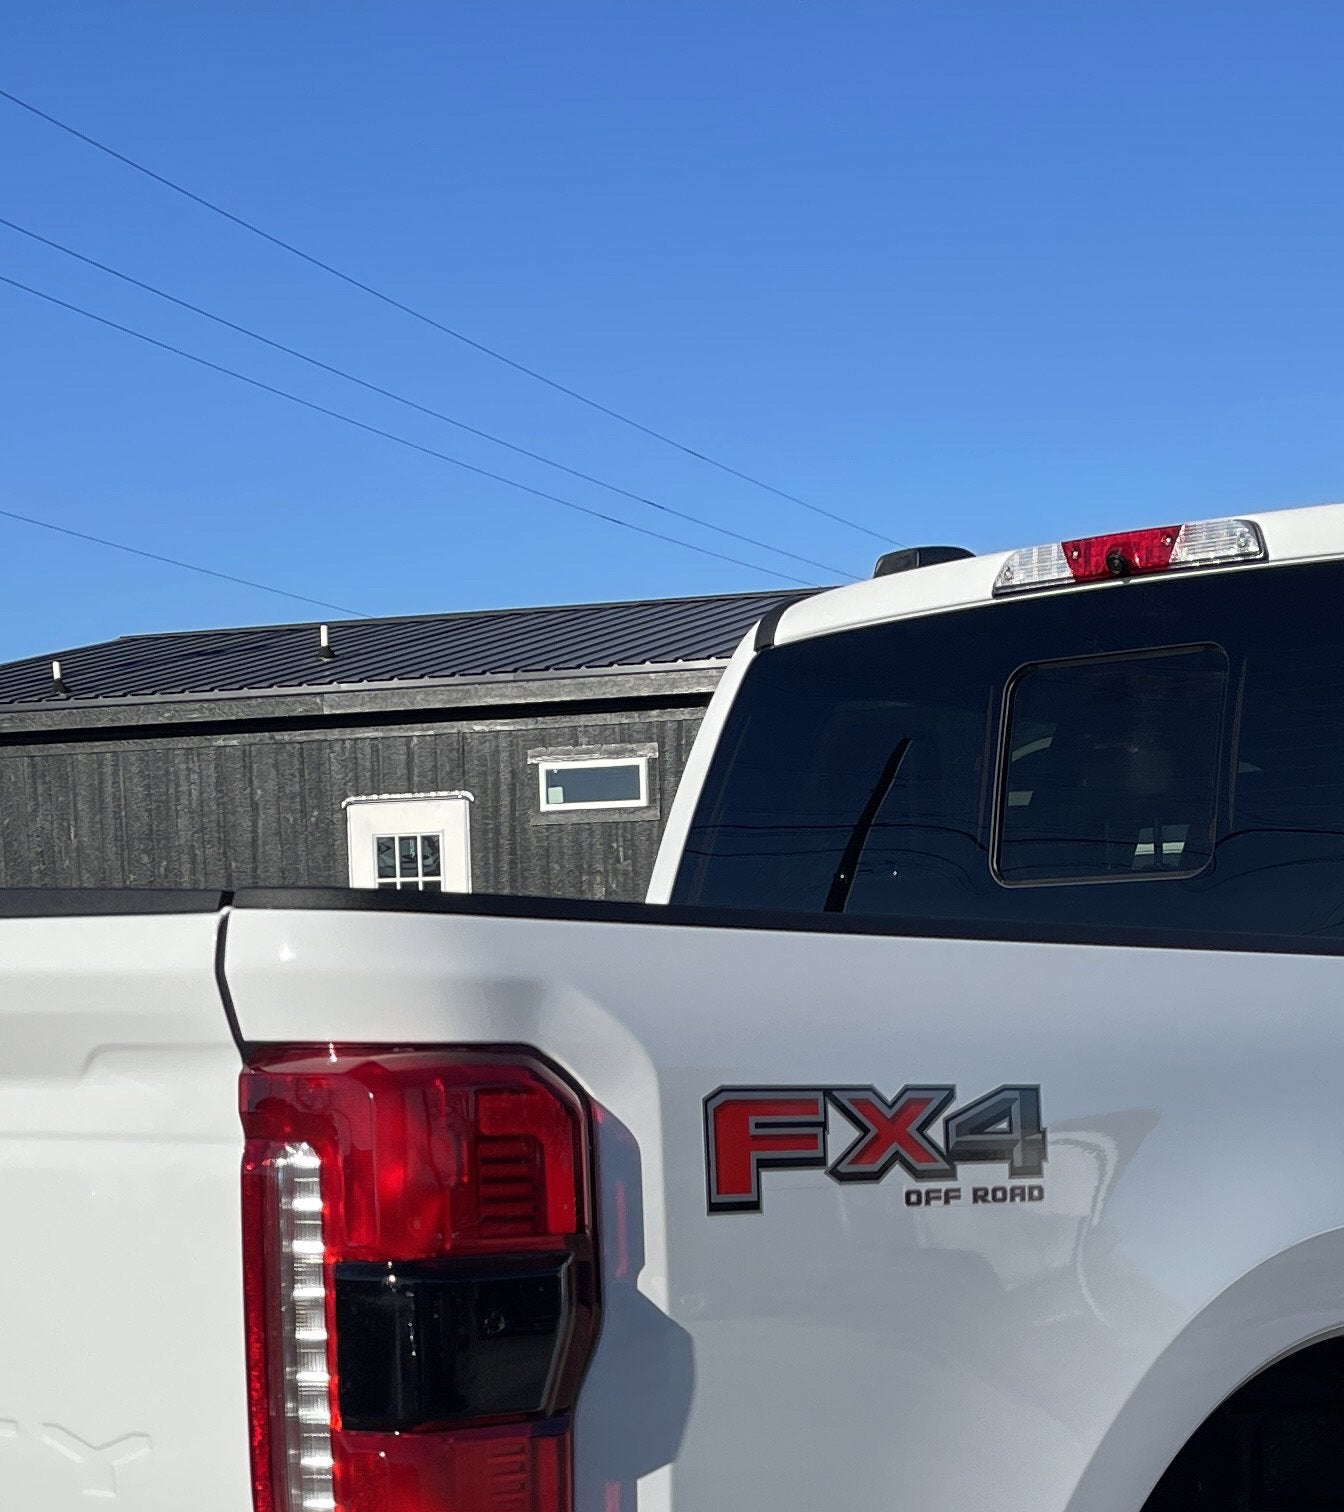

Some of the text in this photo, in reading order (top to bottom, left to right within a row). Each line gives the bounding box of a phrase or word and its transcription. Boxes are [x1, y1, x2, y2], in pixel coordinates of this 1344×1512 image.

[701, 1084, 1048, 1216] FX4
[905, 1184, 1045, 1208] OFF ROAD
